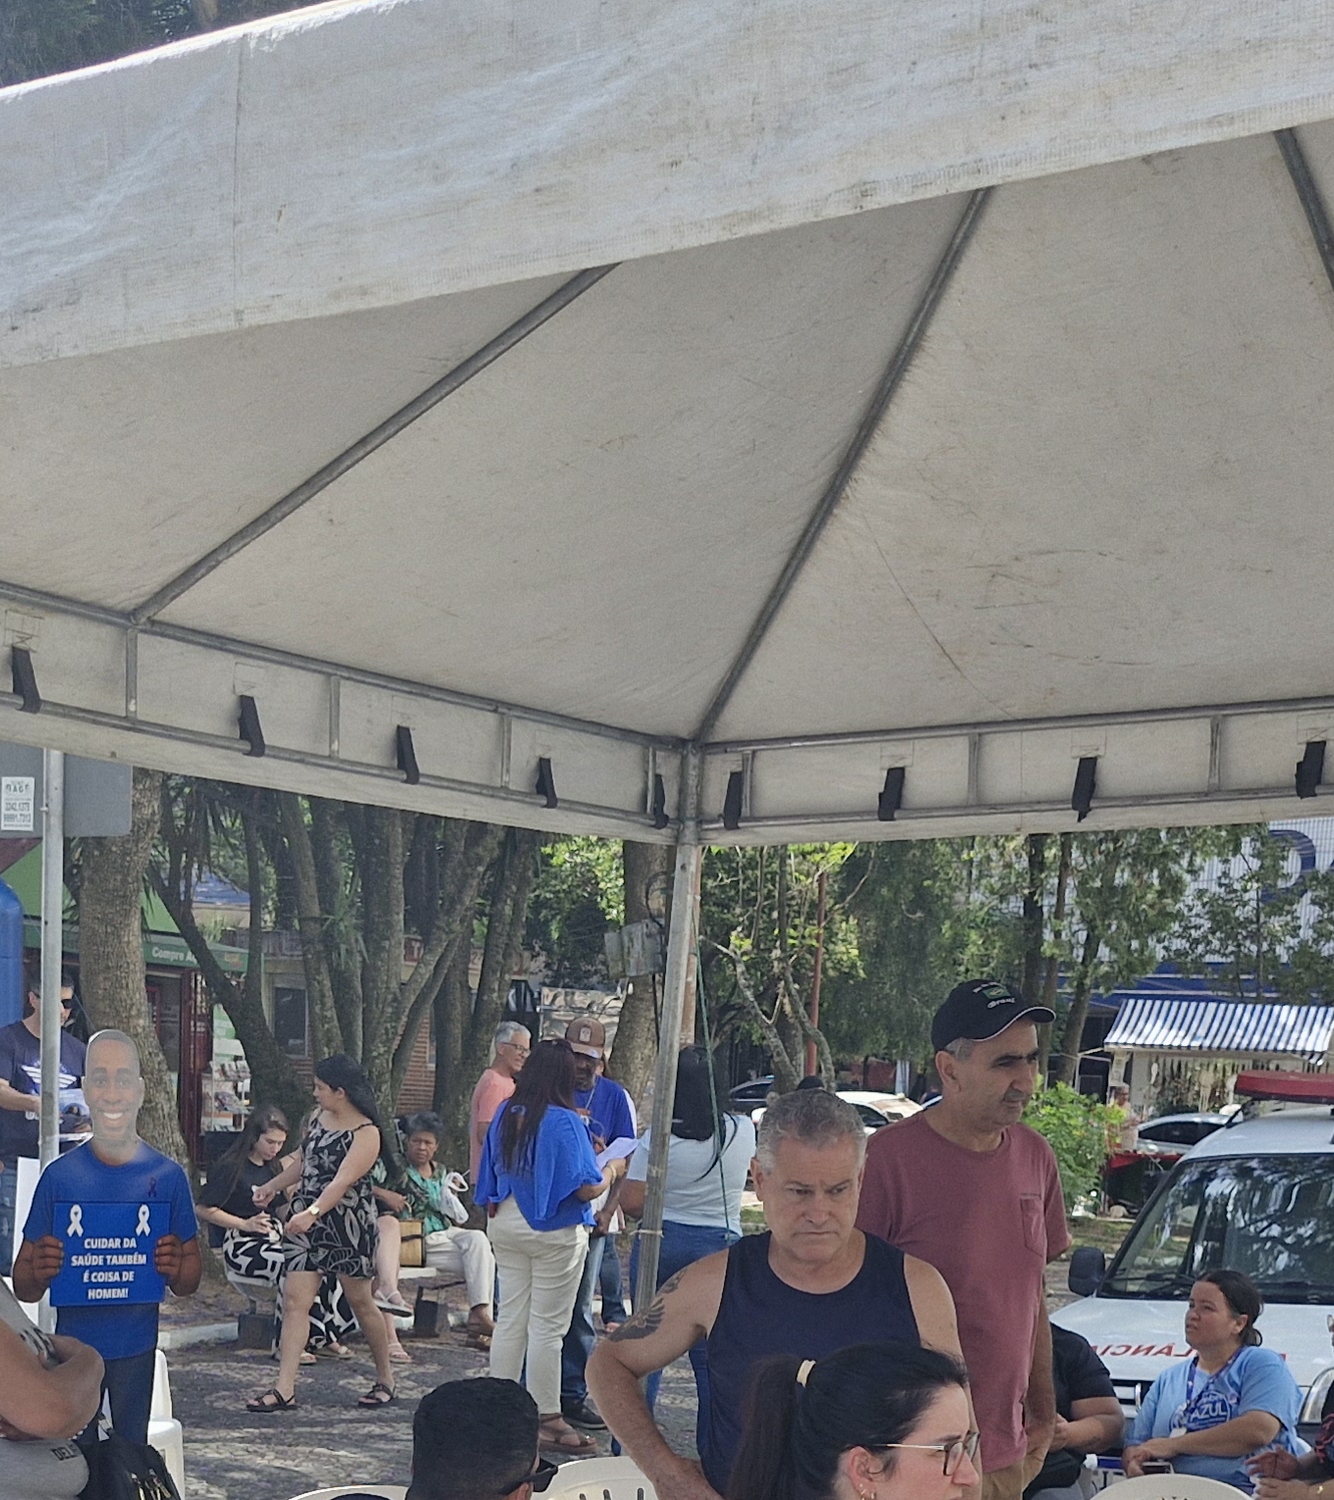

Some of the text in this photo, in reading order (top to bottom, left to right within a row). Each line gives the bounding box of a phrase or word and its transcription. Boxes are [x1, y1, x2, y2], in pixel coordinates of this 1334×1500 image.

[152, 947, 185, 961] Compre
[84, 1237, 137, 1249] CUIDAR DA
[71, 1252, 147, 1266] SAÚDE TAMBÉM
[83, 1270, 134, 1283] É COISA DE
[88, 1288, 128, 1300] HOMEM!
[1190, 1401, 1228, 1419] AZUL
